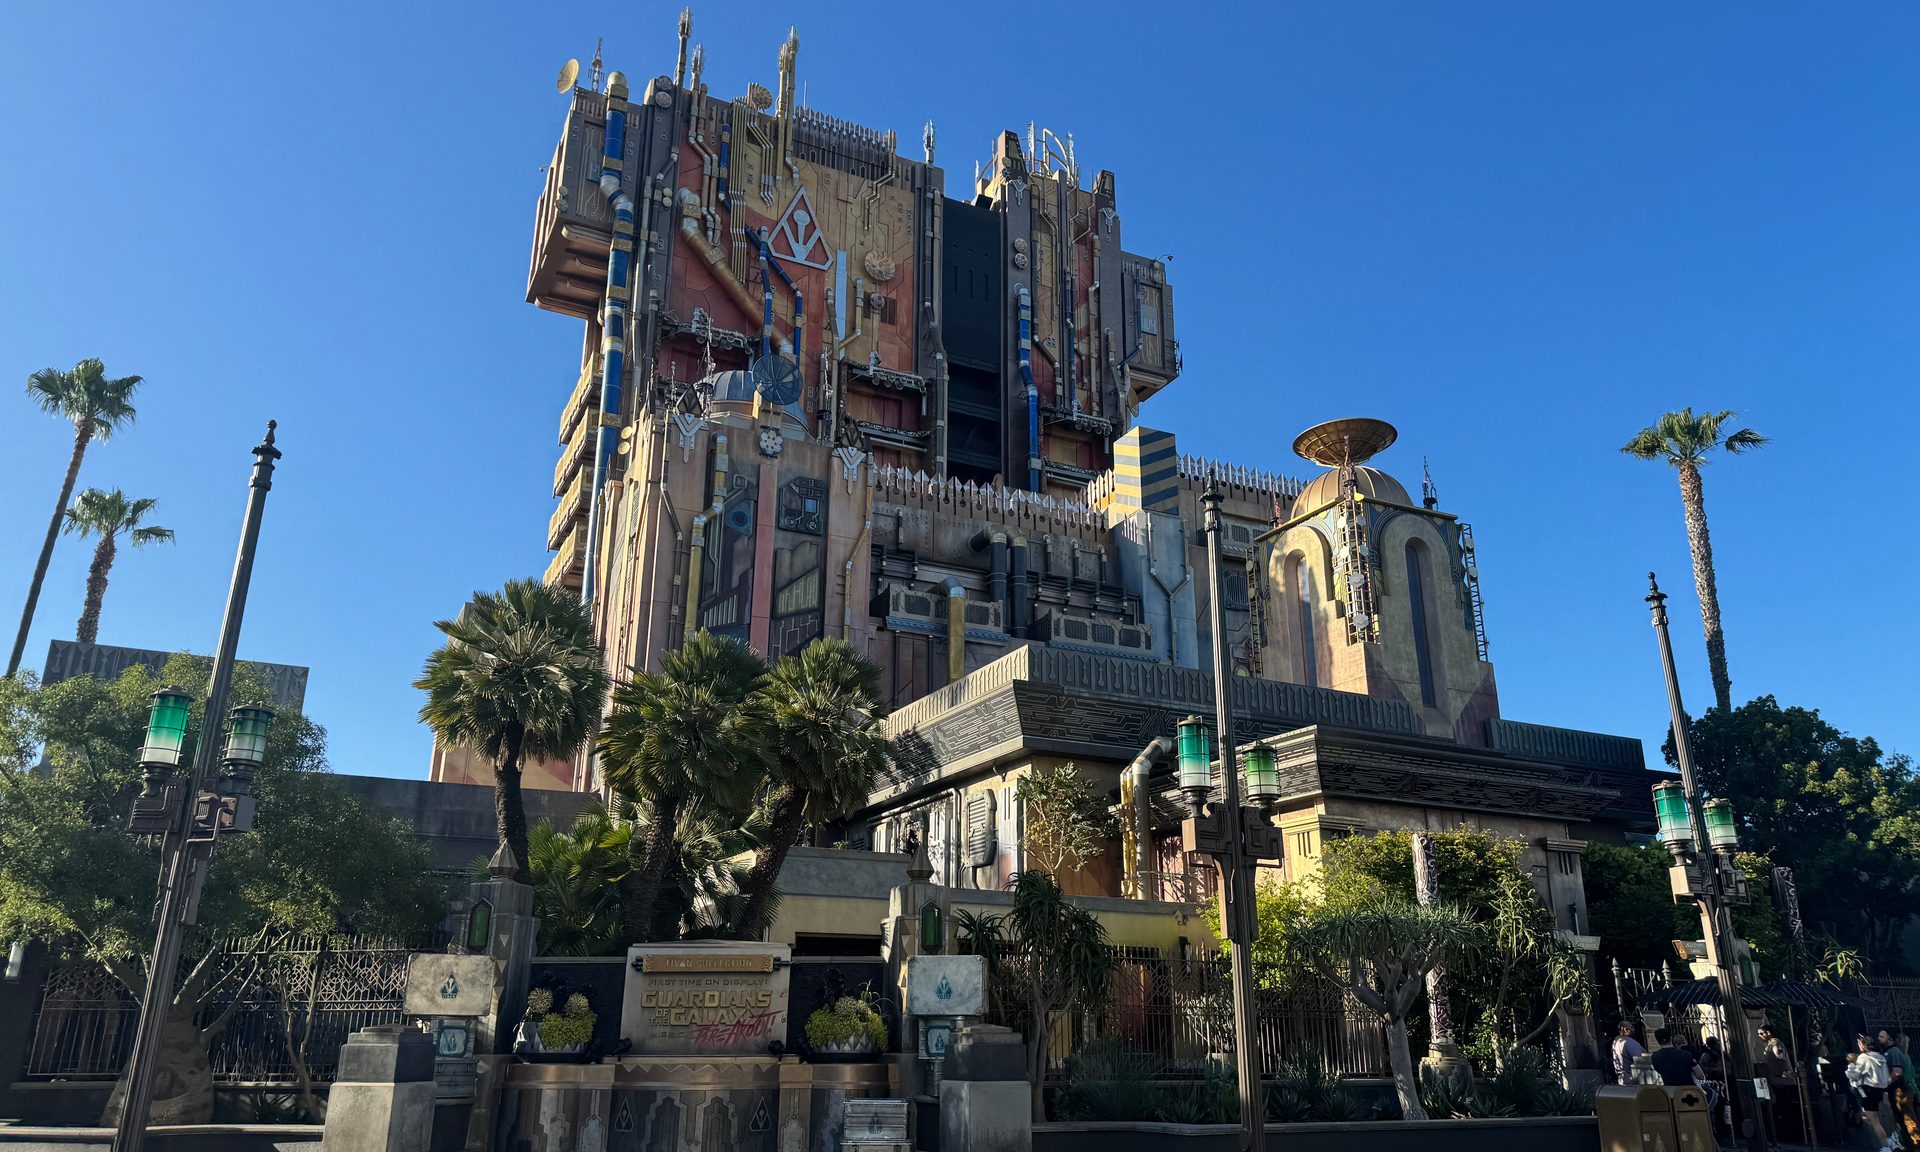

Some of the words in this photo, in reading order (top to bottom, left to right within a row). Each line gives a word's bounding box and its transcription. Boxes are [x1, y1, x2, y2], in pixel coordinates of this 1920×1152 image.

[641, 990, 773, 1008] GUARDIANS
[655, 1008, 669, 1017] OF
[669, 1008, 766, 1026] GALAXY
[650, 1018, 669, 1027] THE
